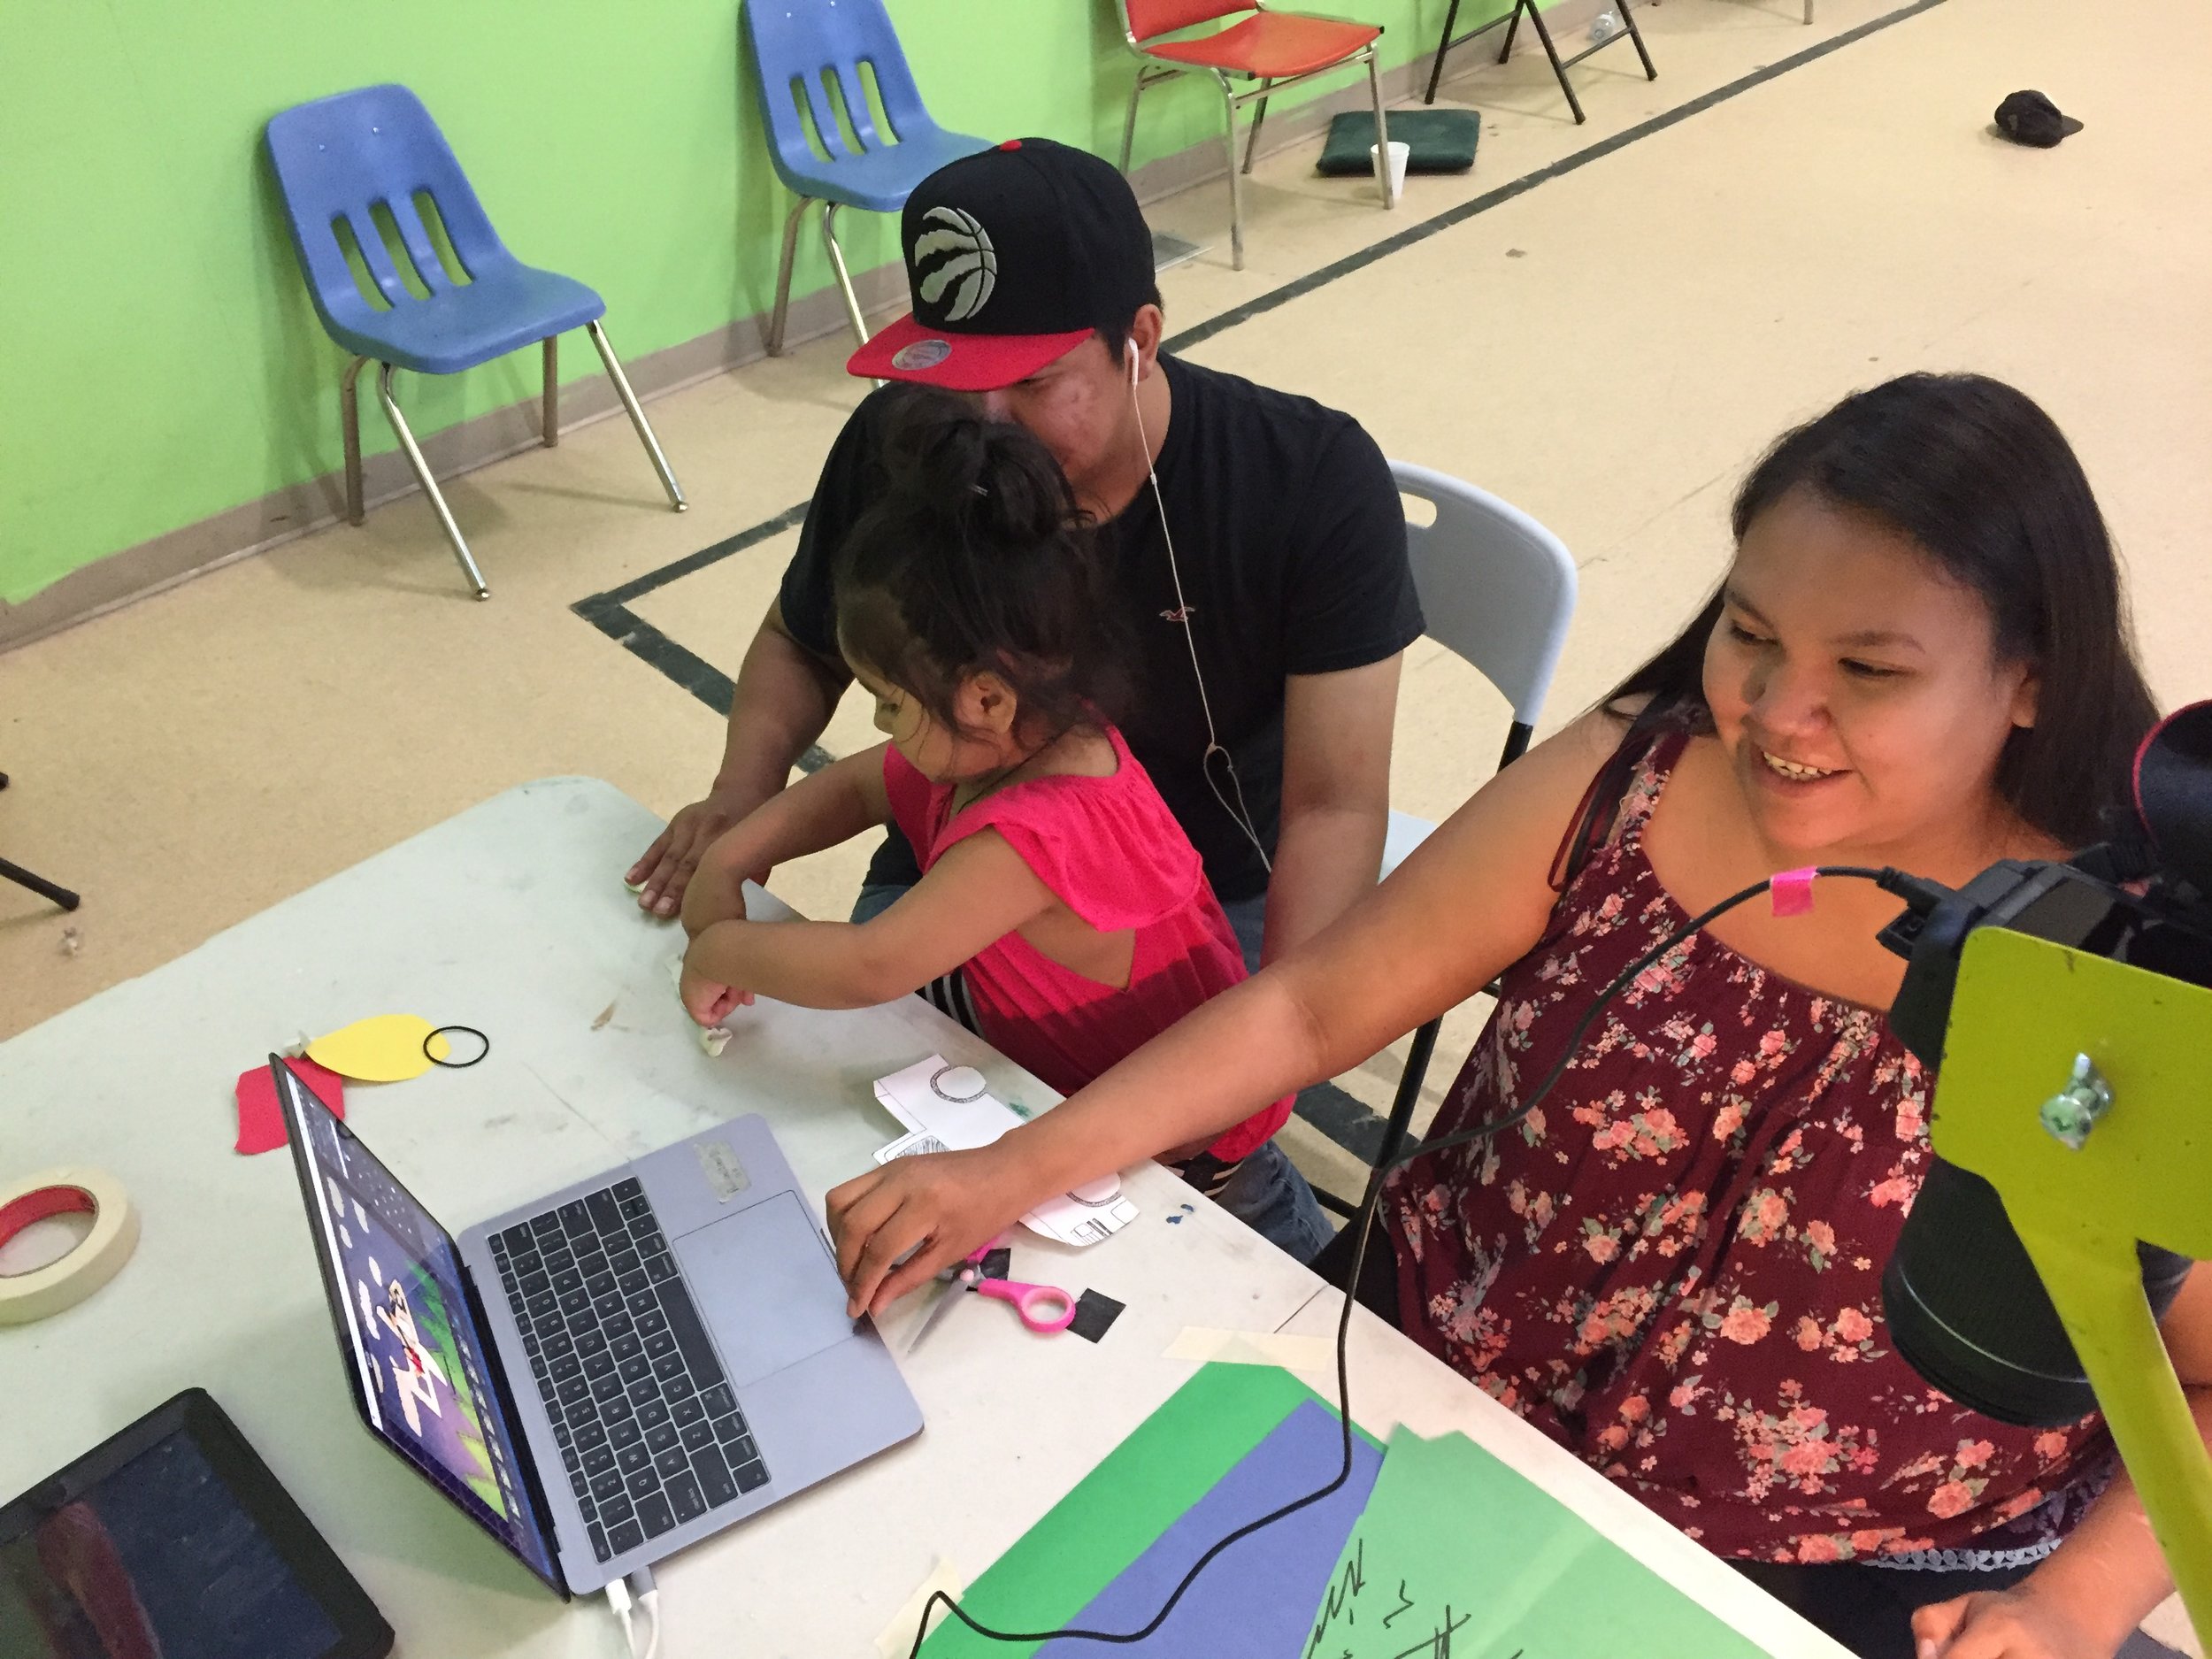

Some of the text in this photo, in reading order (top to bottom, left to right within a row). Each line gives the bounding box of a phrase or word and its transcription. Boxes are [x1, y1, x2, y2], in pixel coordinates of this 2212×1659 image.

[636, 1297, 646, 1307] M
[645, 1318, 654, 1327] N
[620, 1342, 629, 1351] H
[672, 1384, 682, 1393] C
[580, 1406, 591, 1415] 5
[681, 1407, 692, 1416] X
[691, 1431, 701, 1440] Z
[627, 1453, 638, 1463] W
[606, 1478, 617, 1486] 2
[637, 1478, 648, 1486] Q
